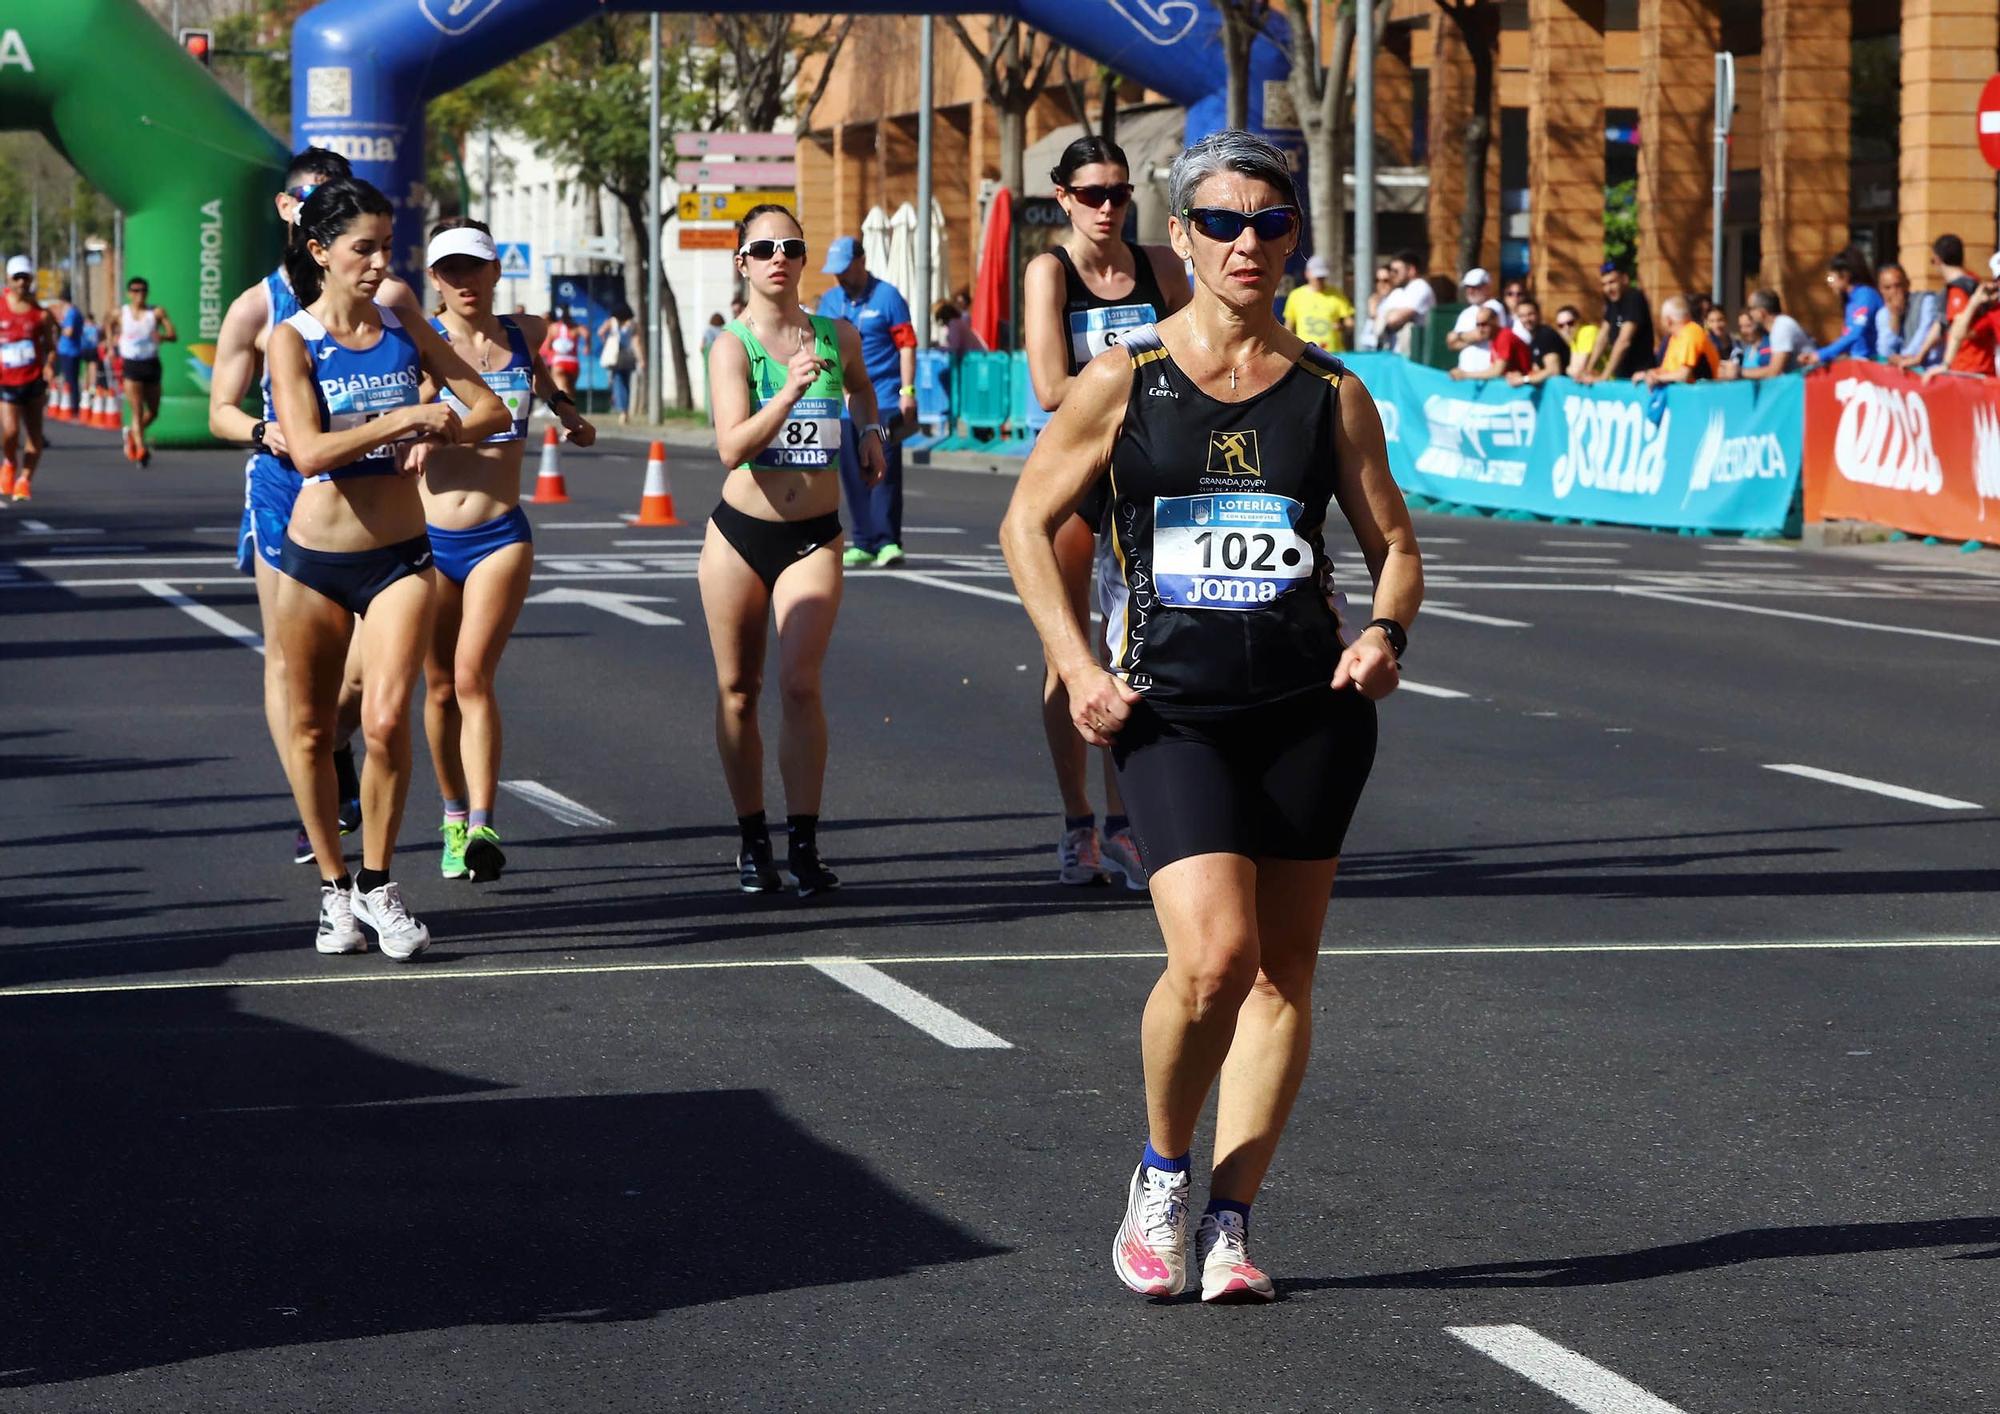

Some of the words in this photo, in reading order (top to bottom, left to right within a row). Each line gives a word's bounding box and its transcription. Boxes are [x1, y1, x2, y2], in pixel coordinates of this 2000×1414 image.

[199, 199, 224, 341] IBERDROLA
[786, 421, 819, 445] 82
[1199, 477, 1240, 487] GRANADA
[1239, 479, 1267, 488] JOVEN
[1219, 499, 1282, 512] LOTERÍAS
[1194, 531, 1277, 572] 102
